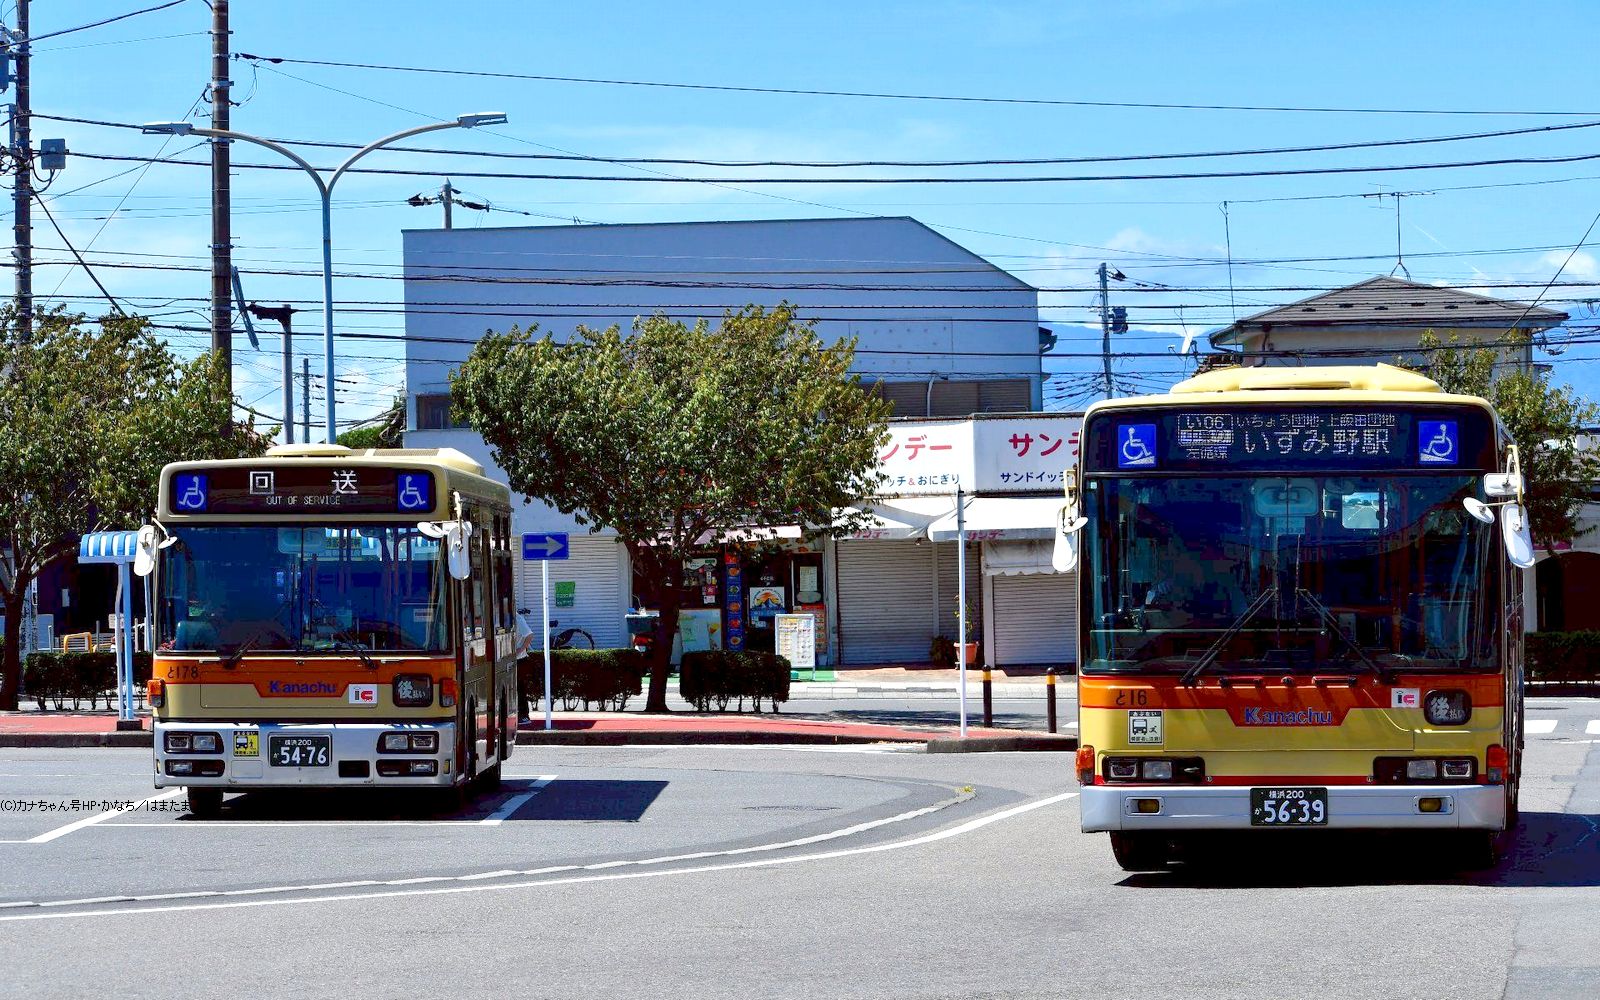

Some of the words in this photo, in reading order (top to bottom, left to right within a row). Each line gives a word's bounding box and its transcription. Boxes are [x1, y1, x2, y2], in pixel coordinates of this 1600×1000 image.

[1245, 429, 1390, 455] いずみ野駅
[266, 495, 282, 505] OUT
[287, 495, 298, 505] OF
[303, 495, 341, 505] SERVICE
[167, 666, 199, 680] と178
[268, 680, 337, 694] Kanachu
[1115, 689, 1148, 706] と16
[1244, 706, 1333, 725] Kanachu
[280, 746, 327, 765] 54-76
[1268, 790, 1305, 799] 横浜200
[1263, 799, 1325, 822] 56-39
